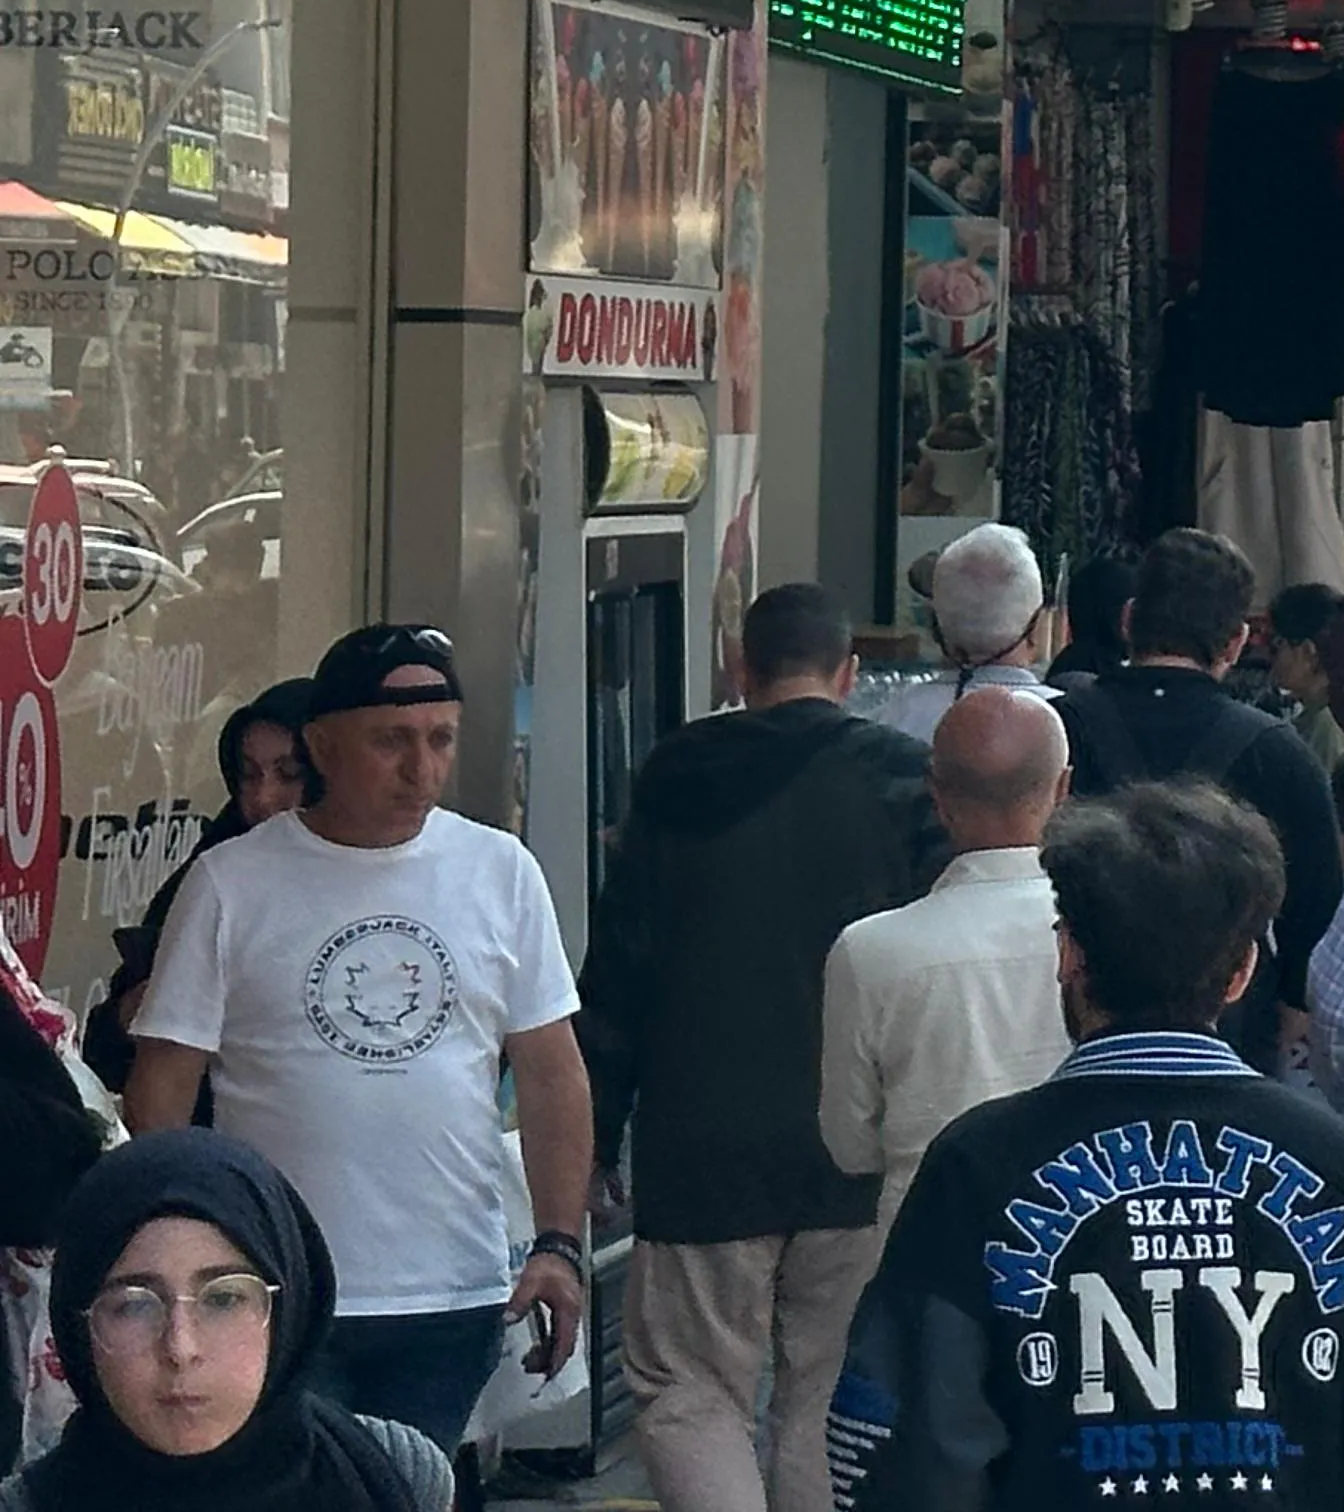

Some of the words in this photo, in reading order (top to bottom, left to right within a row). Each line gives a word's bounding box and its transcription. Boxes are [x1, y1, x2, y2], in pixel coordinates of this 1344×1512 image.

[7, 249, 115, 281] POLO
[556, 292, 698, 371] DONDURMA
[31, 520, 77, 625] 30
[0, 692, 46, 870] 0
[310, 920, 421, 984] LUMBERJACK
[1126, 1198, 1234, 1227] SKATE
[1131, 1233, 1235, 1262] BOARD
[1070, 1267, 1295, 1414] NY
[1080, 1420, 1287, 1471] DISTRICT
